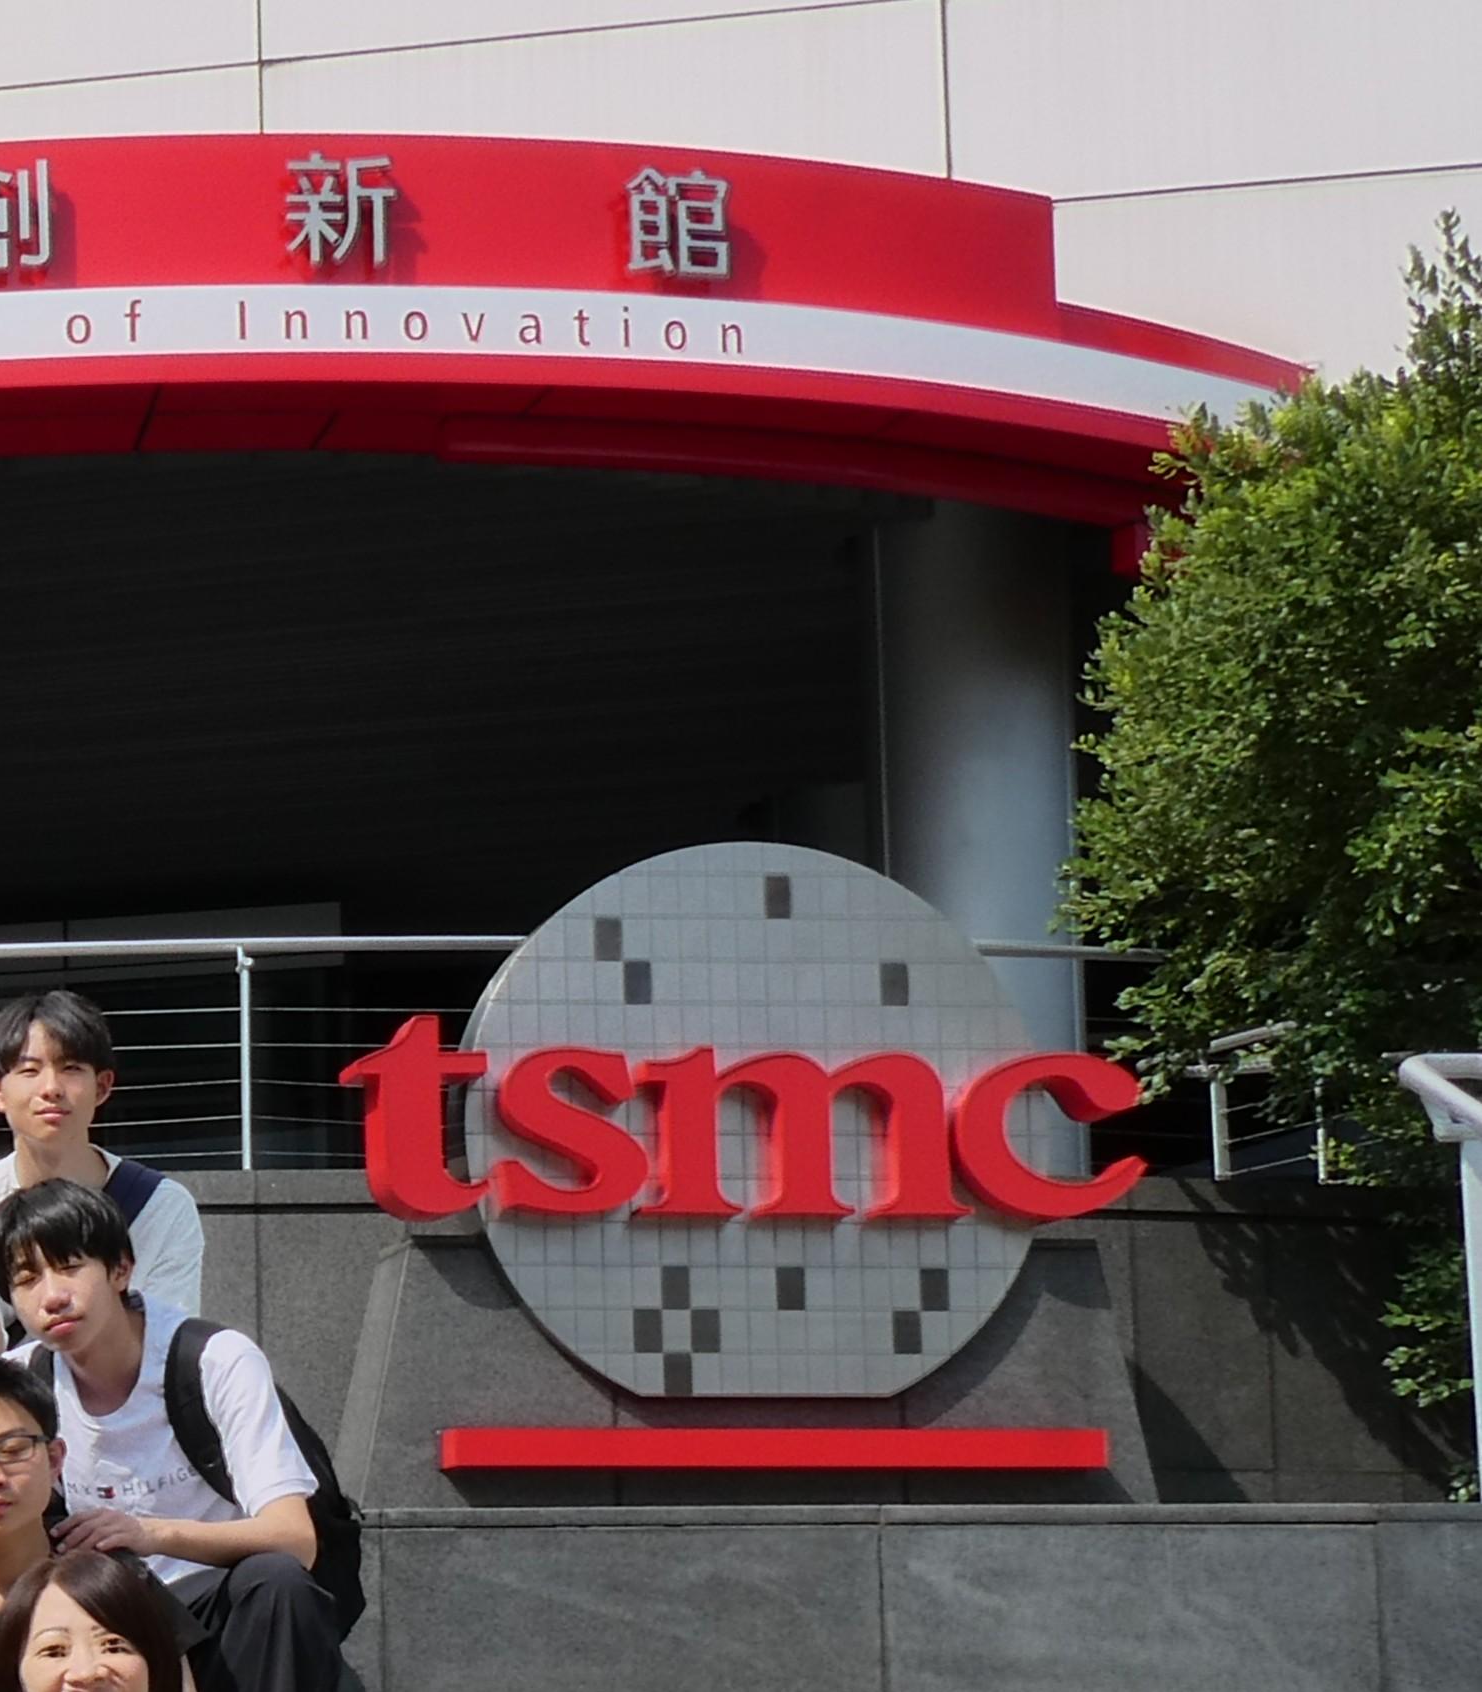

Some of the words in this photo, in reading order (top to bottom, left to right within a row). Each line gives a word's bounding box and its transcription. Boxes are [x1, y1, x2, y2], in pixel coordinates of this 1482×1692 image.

[65, 298, 144, 346] of
[238, 299, 745, 355] Innovation
[339, 1014, 1148, 1222] tsmc
[122, 1465, 197, 1496] HILFIGE
